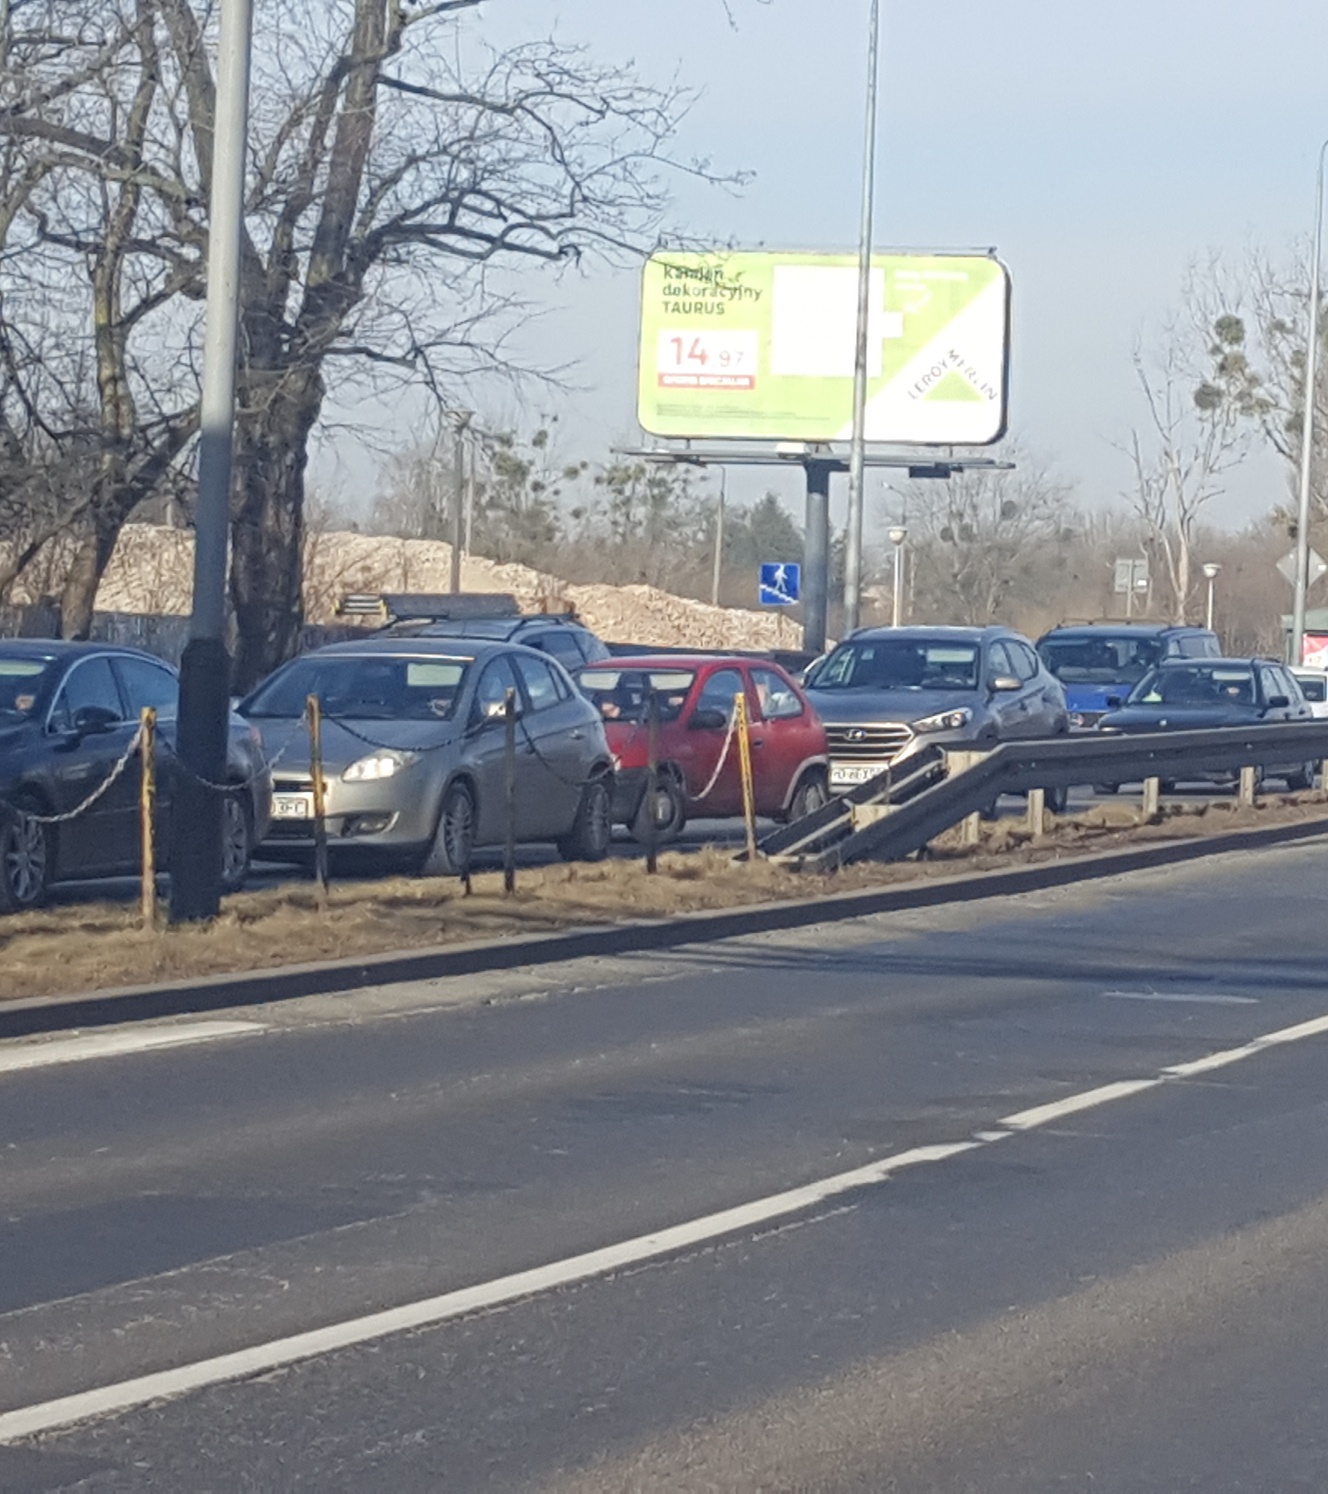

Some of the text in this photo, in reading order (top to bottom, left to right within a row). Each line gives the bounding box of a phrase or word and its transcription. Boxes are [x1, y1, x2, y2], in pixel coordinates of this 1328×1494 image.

[663, 283, 763, 302] dekoracyjny
[662, 301, 725, 315] TAURUS
[907, 358, 948, 400] LEROY
